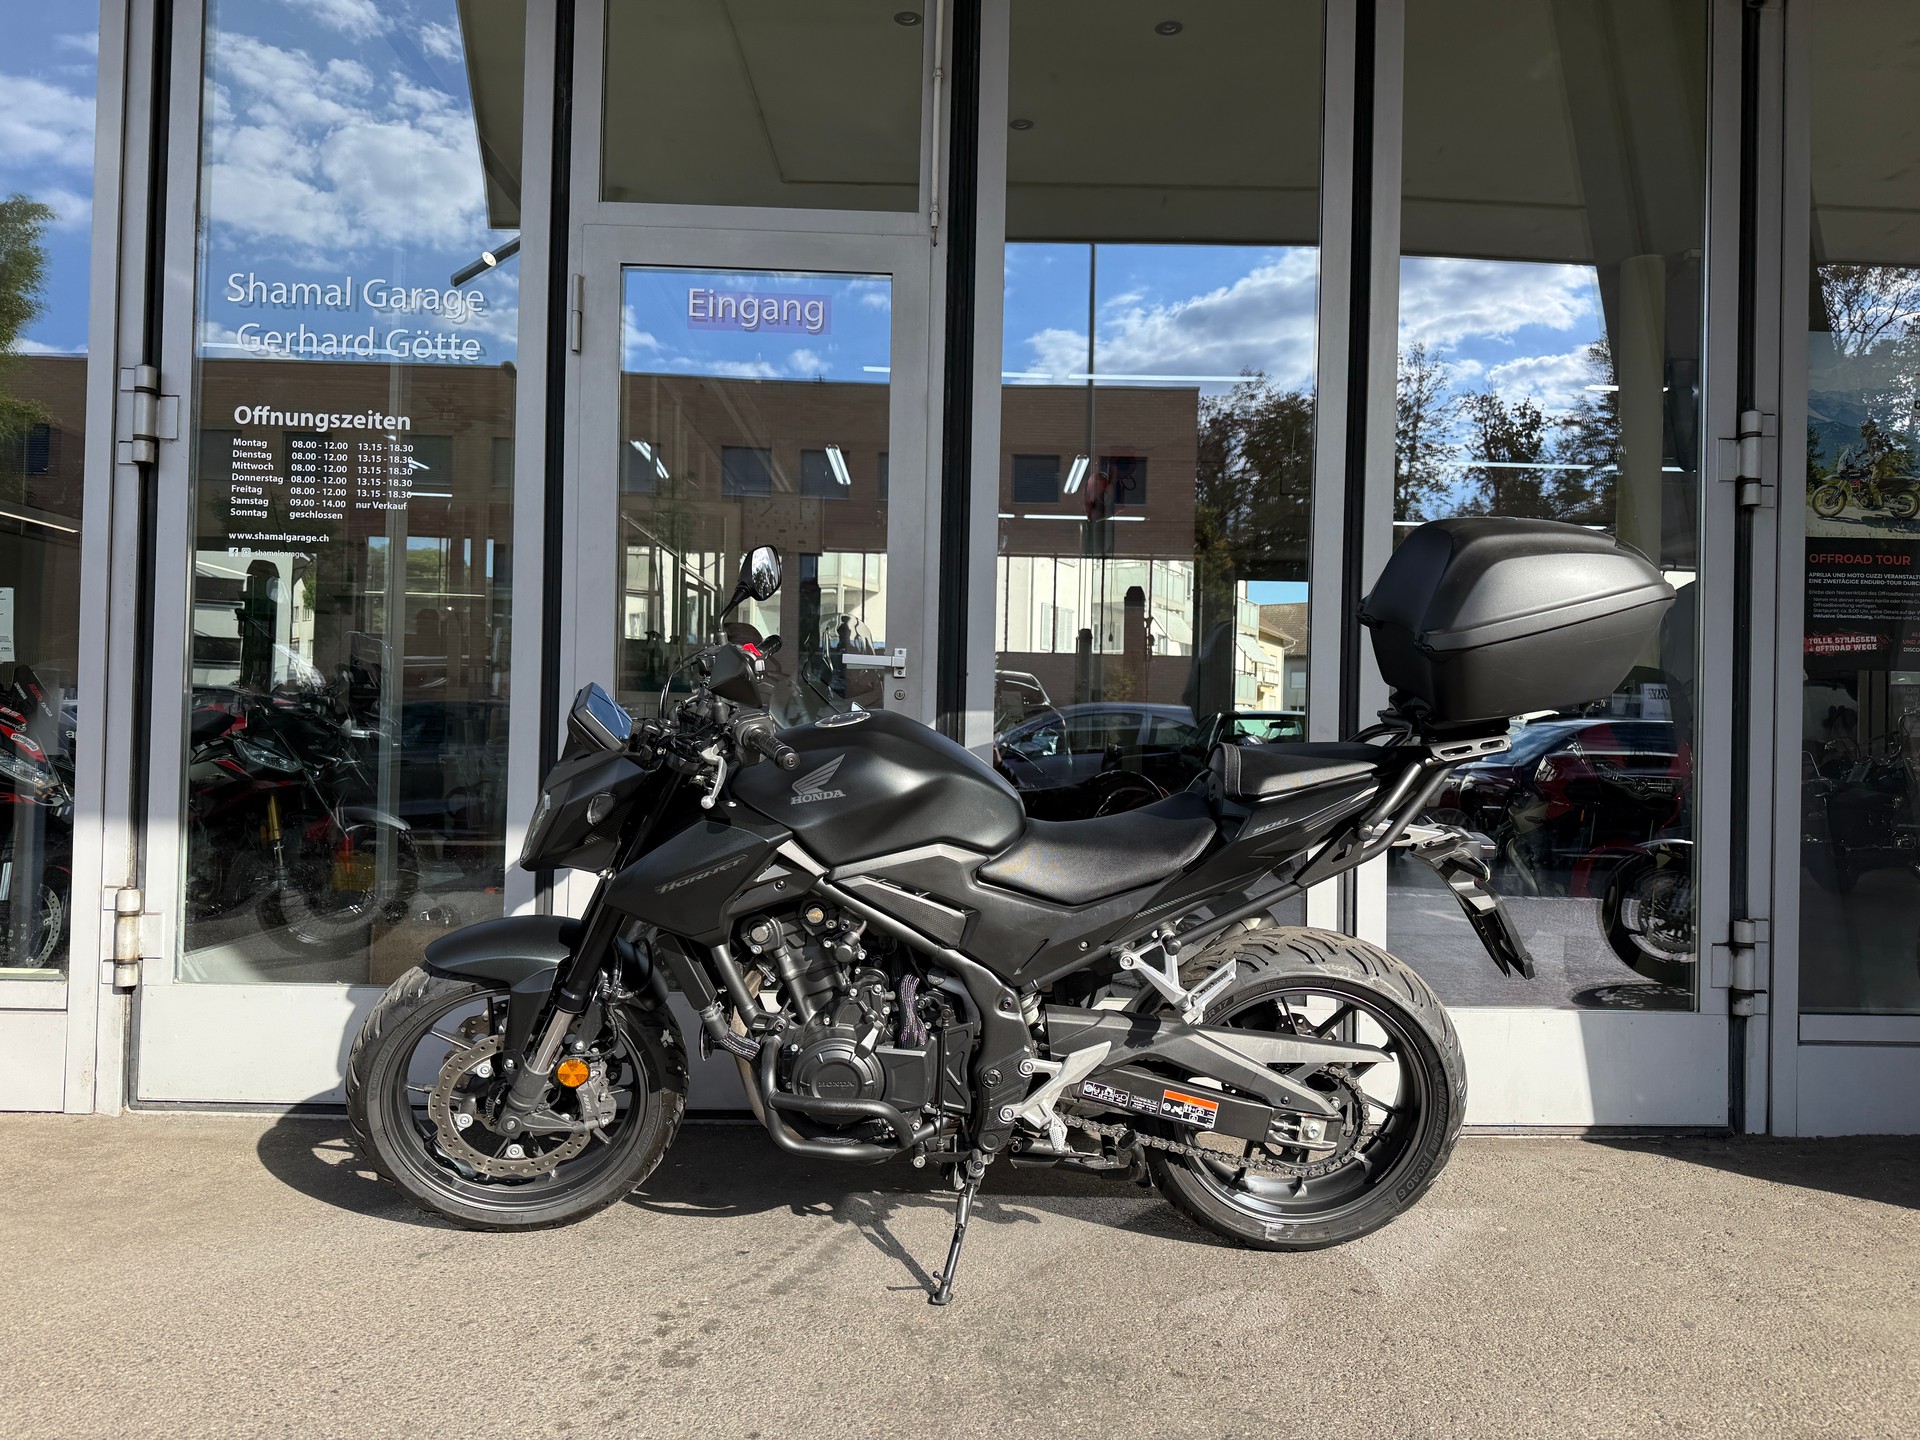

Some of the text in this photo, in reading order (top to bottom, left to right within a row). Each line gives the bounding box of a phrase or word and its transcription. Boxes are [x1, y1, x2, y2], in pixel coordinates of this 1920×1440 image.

[227, 272, 485, 320] Shamal Garage
[688, 288, 824, 331] Eingang
[236, 322, 481, 361] Gerhard Götte
[233, 438, 267, 448] Montag
[359, 443, 382, 451] 13.15
[390, 444, 413, 452] 18.30
[233, 450, 272, 460] Dienstag
[292, 452, 316, 460] 08.00
[232, 462, 273, 470] Mittwoch
[324, 465, 347, 473] 12.00
[389, 467, 413, 475] 18.30
[232, 473, 283, 484] Donnerstag
[389, 479, 412, 487] 18.30
[232, 485, 262, 495] Freitag
[291, 487, 315, 495] 08.00
[231, 497, 268, 507] Samstag
[373, 502, 407, 510] Verkauf
[231, 508, 342, 519] Sonntag geschlossen
[229, 532, 329, 543] www.shamalgarage.ch
[1809, 554, 1911, 566] OFFROAD TOUR
[1835, 636, 1877, 644] STRASSEN
[1815, 644, 1851, 652] OFFROAD
[1853, 643, 1877, 651] WEGE
[790, 789, 846, 805] HONDA
[1252, 817, 1289, 835] 500
[1406, 1157, 1431, 1190] ROAD
